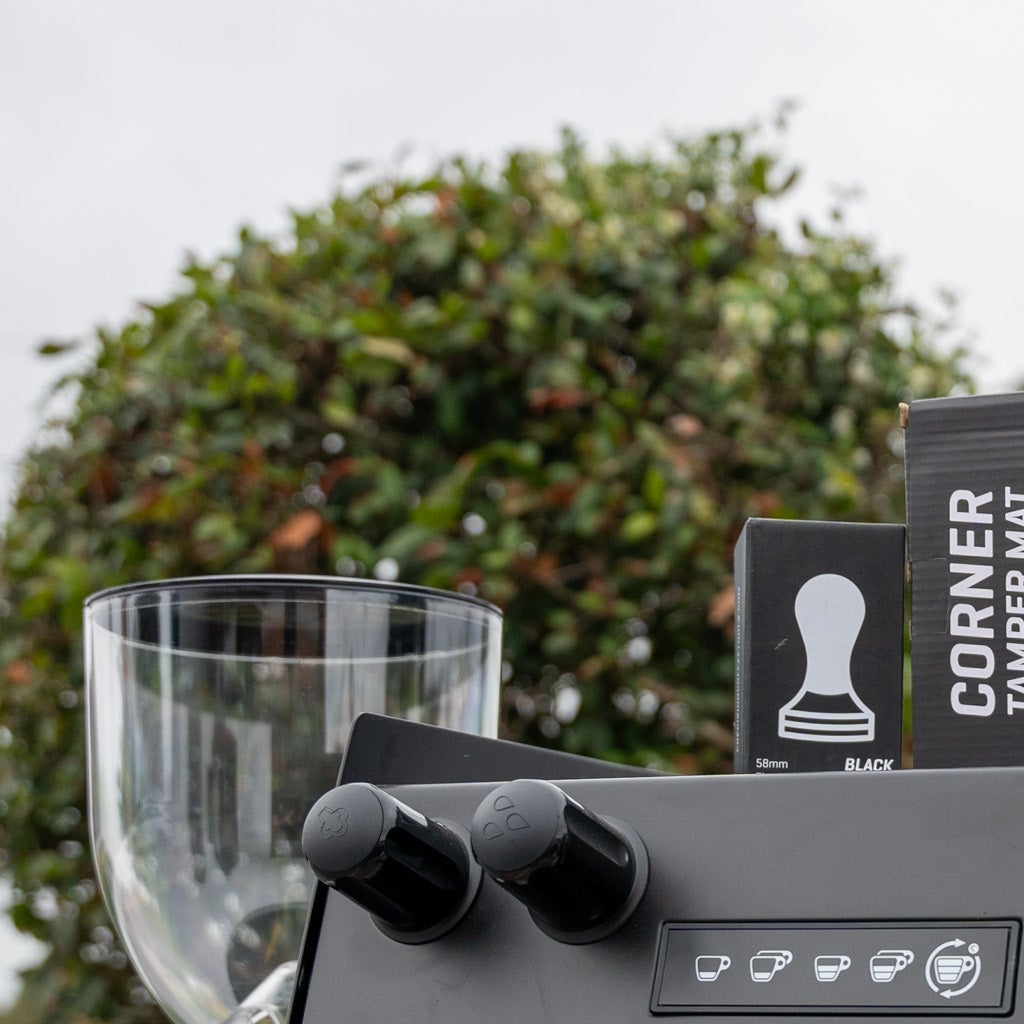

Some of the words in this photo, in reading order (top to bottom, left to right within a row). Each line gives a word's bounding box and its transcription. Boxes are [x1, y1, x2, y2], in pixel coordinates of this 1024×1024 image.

[949, 489, 996, 717] CORNER
[755, 758, 789, 769] 58mm
[844, 757, 894, 772] BLACK
